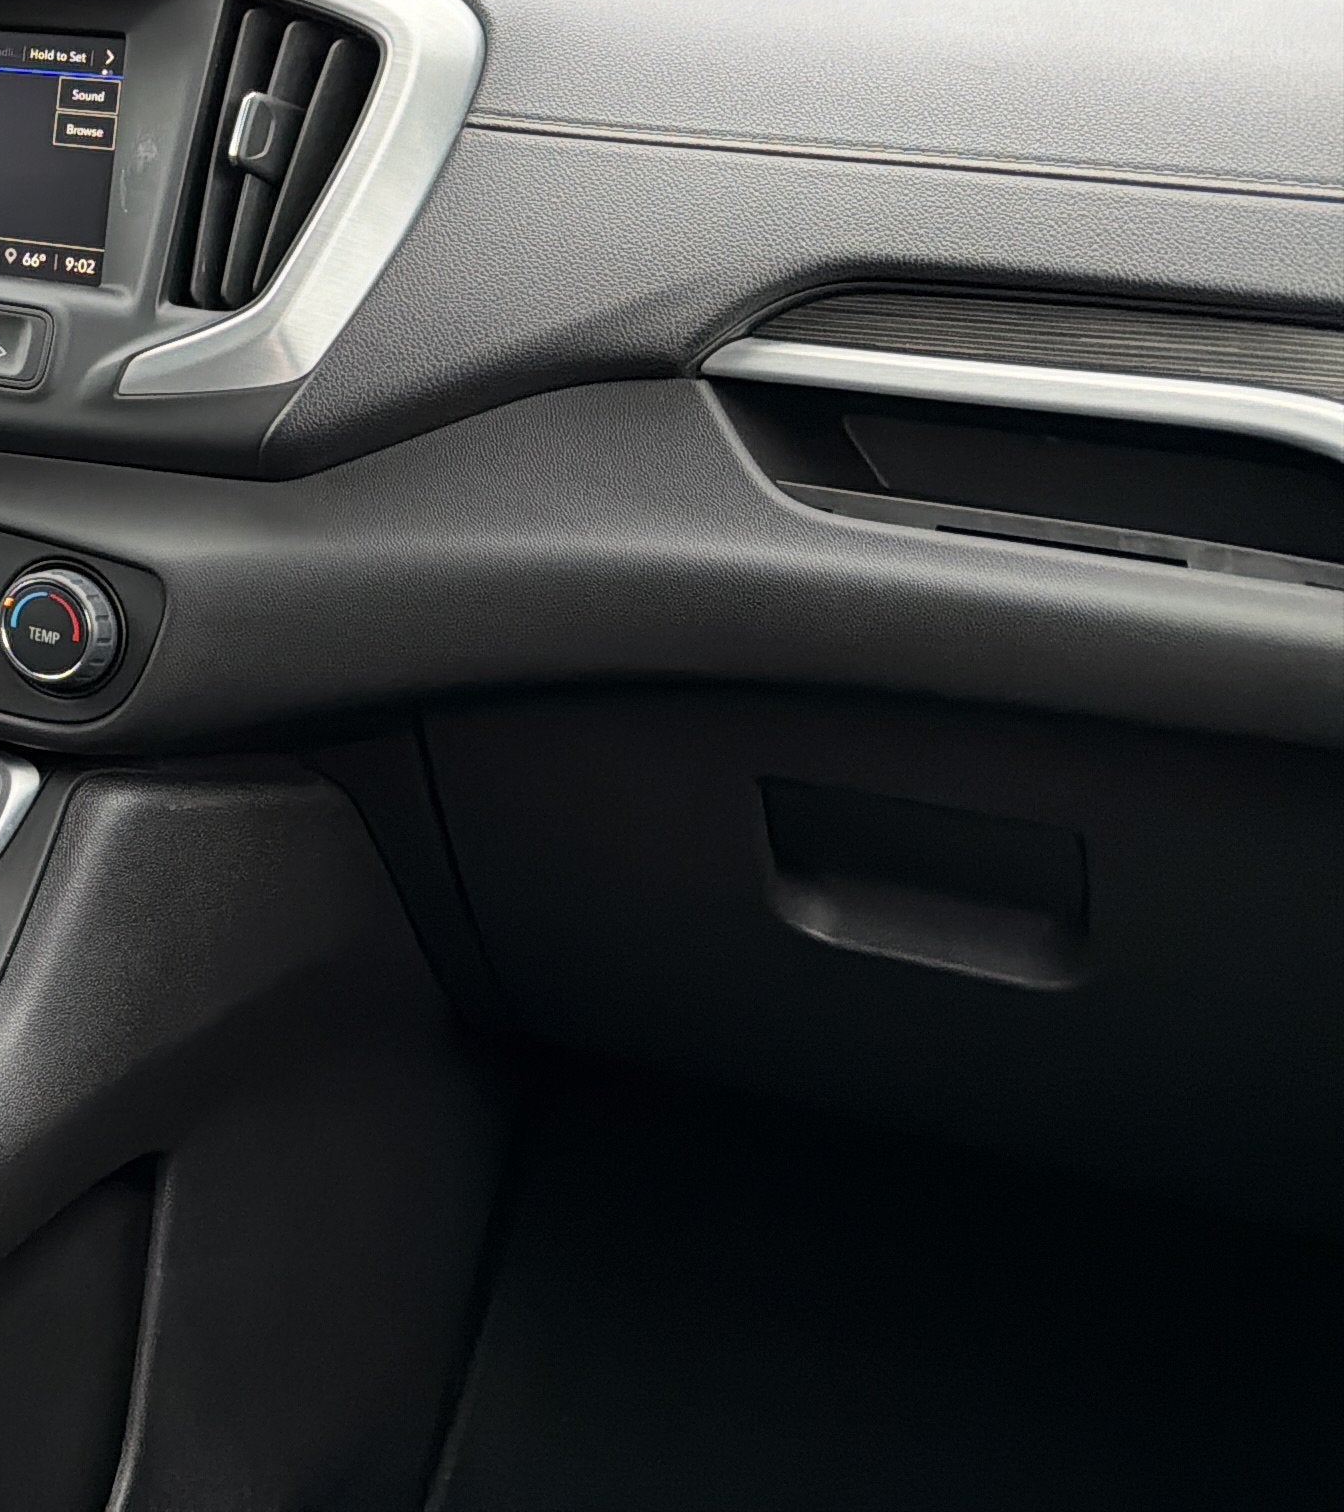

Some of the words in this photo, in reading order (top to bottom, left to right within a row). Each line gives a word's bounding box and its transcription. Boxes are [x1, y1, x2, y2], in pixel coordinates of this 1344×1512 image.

[29, 48, 55, 61] Hold
[56, 50, 68, 62] to
[69, 51, 88, 64] Set
[71, 89, 106, 103] Sound
[66, 123, 105, 138] Browse
[22, 251, 47, 268] 66°
[64, 256, 96, 275] 9:02
[28, 626, 61, 646] TEMP
